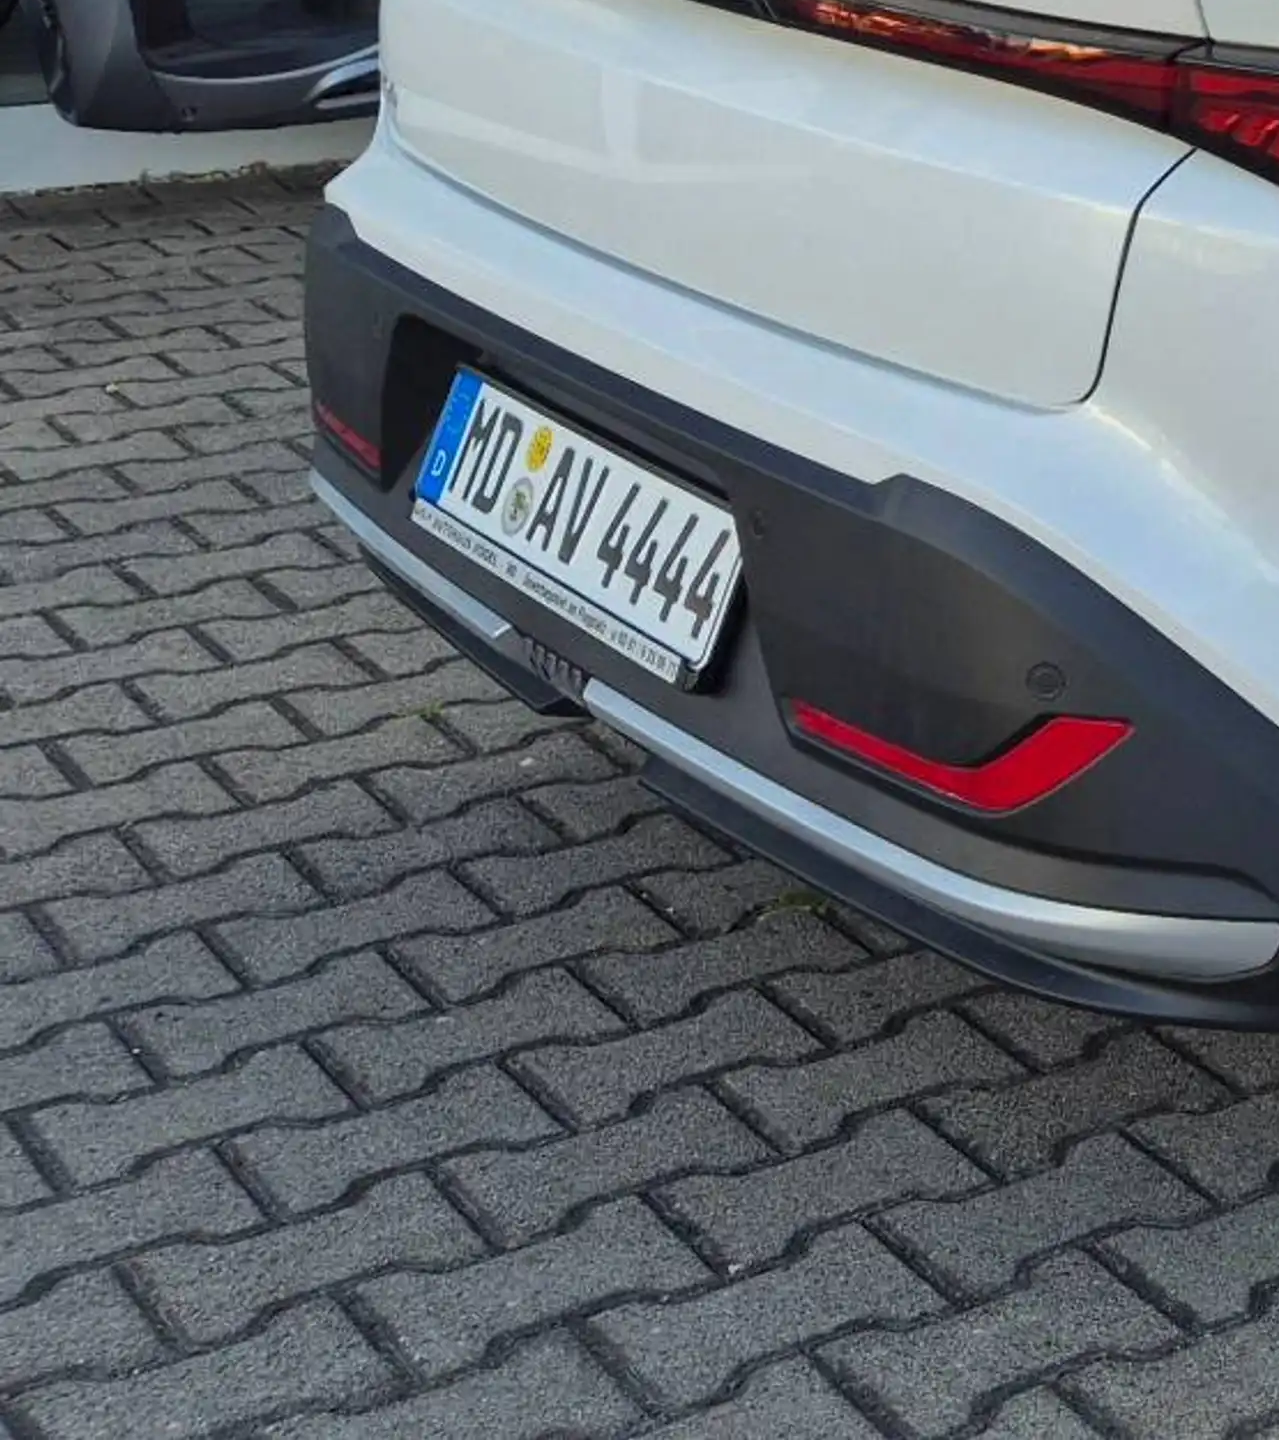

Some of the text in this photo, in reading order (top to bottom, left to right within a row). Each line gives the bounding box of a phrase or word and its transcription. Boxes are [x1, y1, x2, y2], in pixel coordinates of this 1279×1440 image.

[431, 449, 447, 477] D
[448, 397, 524, 515] MD
[525, 446, 610, 566] AV
[597, 481, 731, 640] 4444
